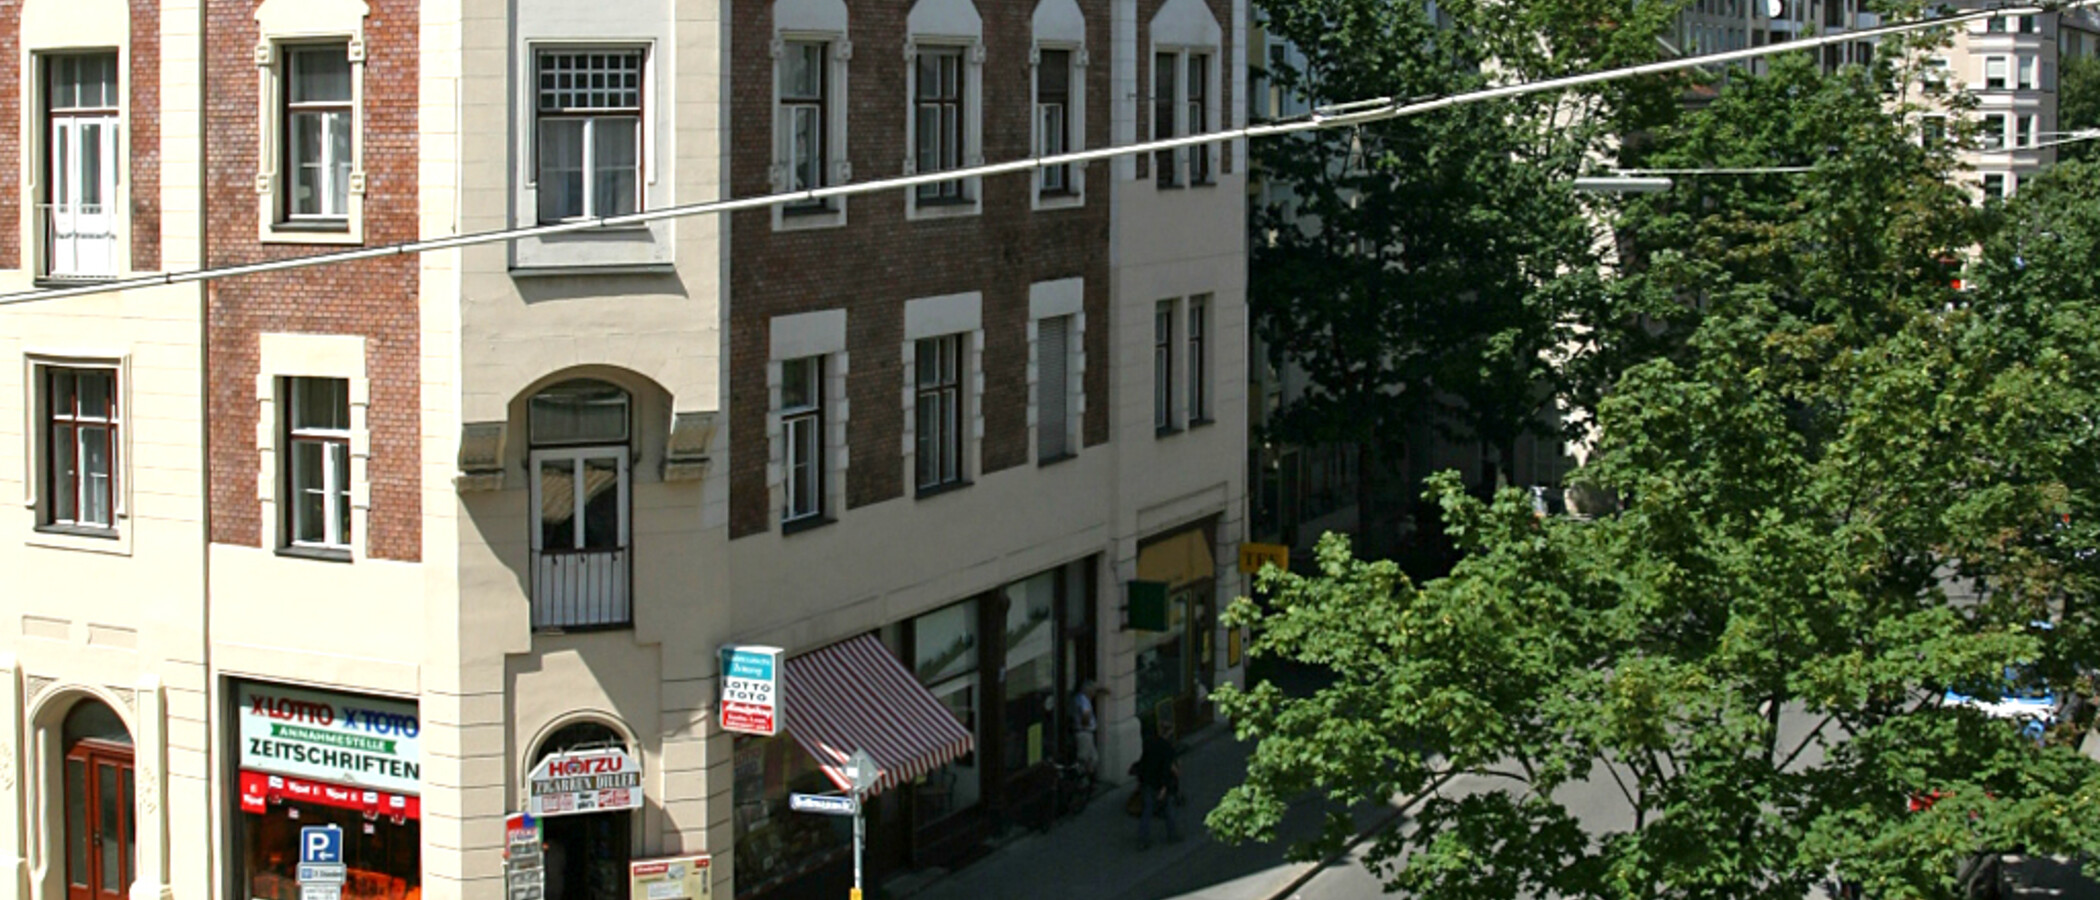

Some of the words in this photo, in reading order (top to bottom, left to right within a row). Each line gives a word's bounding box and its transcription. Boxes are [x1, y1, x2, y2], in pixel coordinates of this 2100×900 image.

[723, 679, 772, 693] LOTTO
[729, 689, 767, 702] TOTO
[267, 697, 334, 726] LOTTO
[362, 709, 419, 738] TOTO
[278, 726, 386, 750] ANNAHMESTELLE
[250, 737, 419, 780] ZEITSCHRIFTEN
[597, 773, 637, 789] DILLER
[307, 832, 329, 861] P
